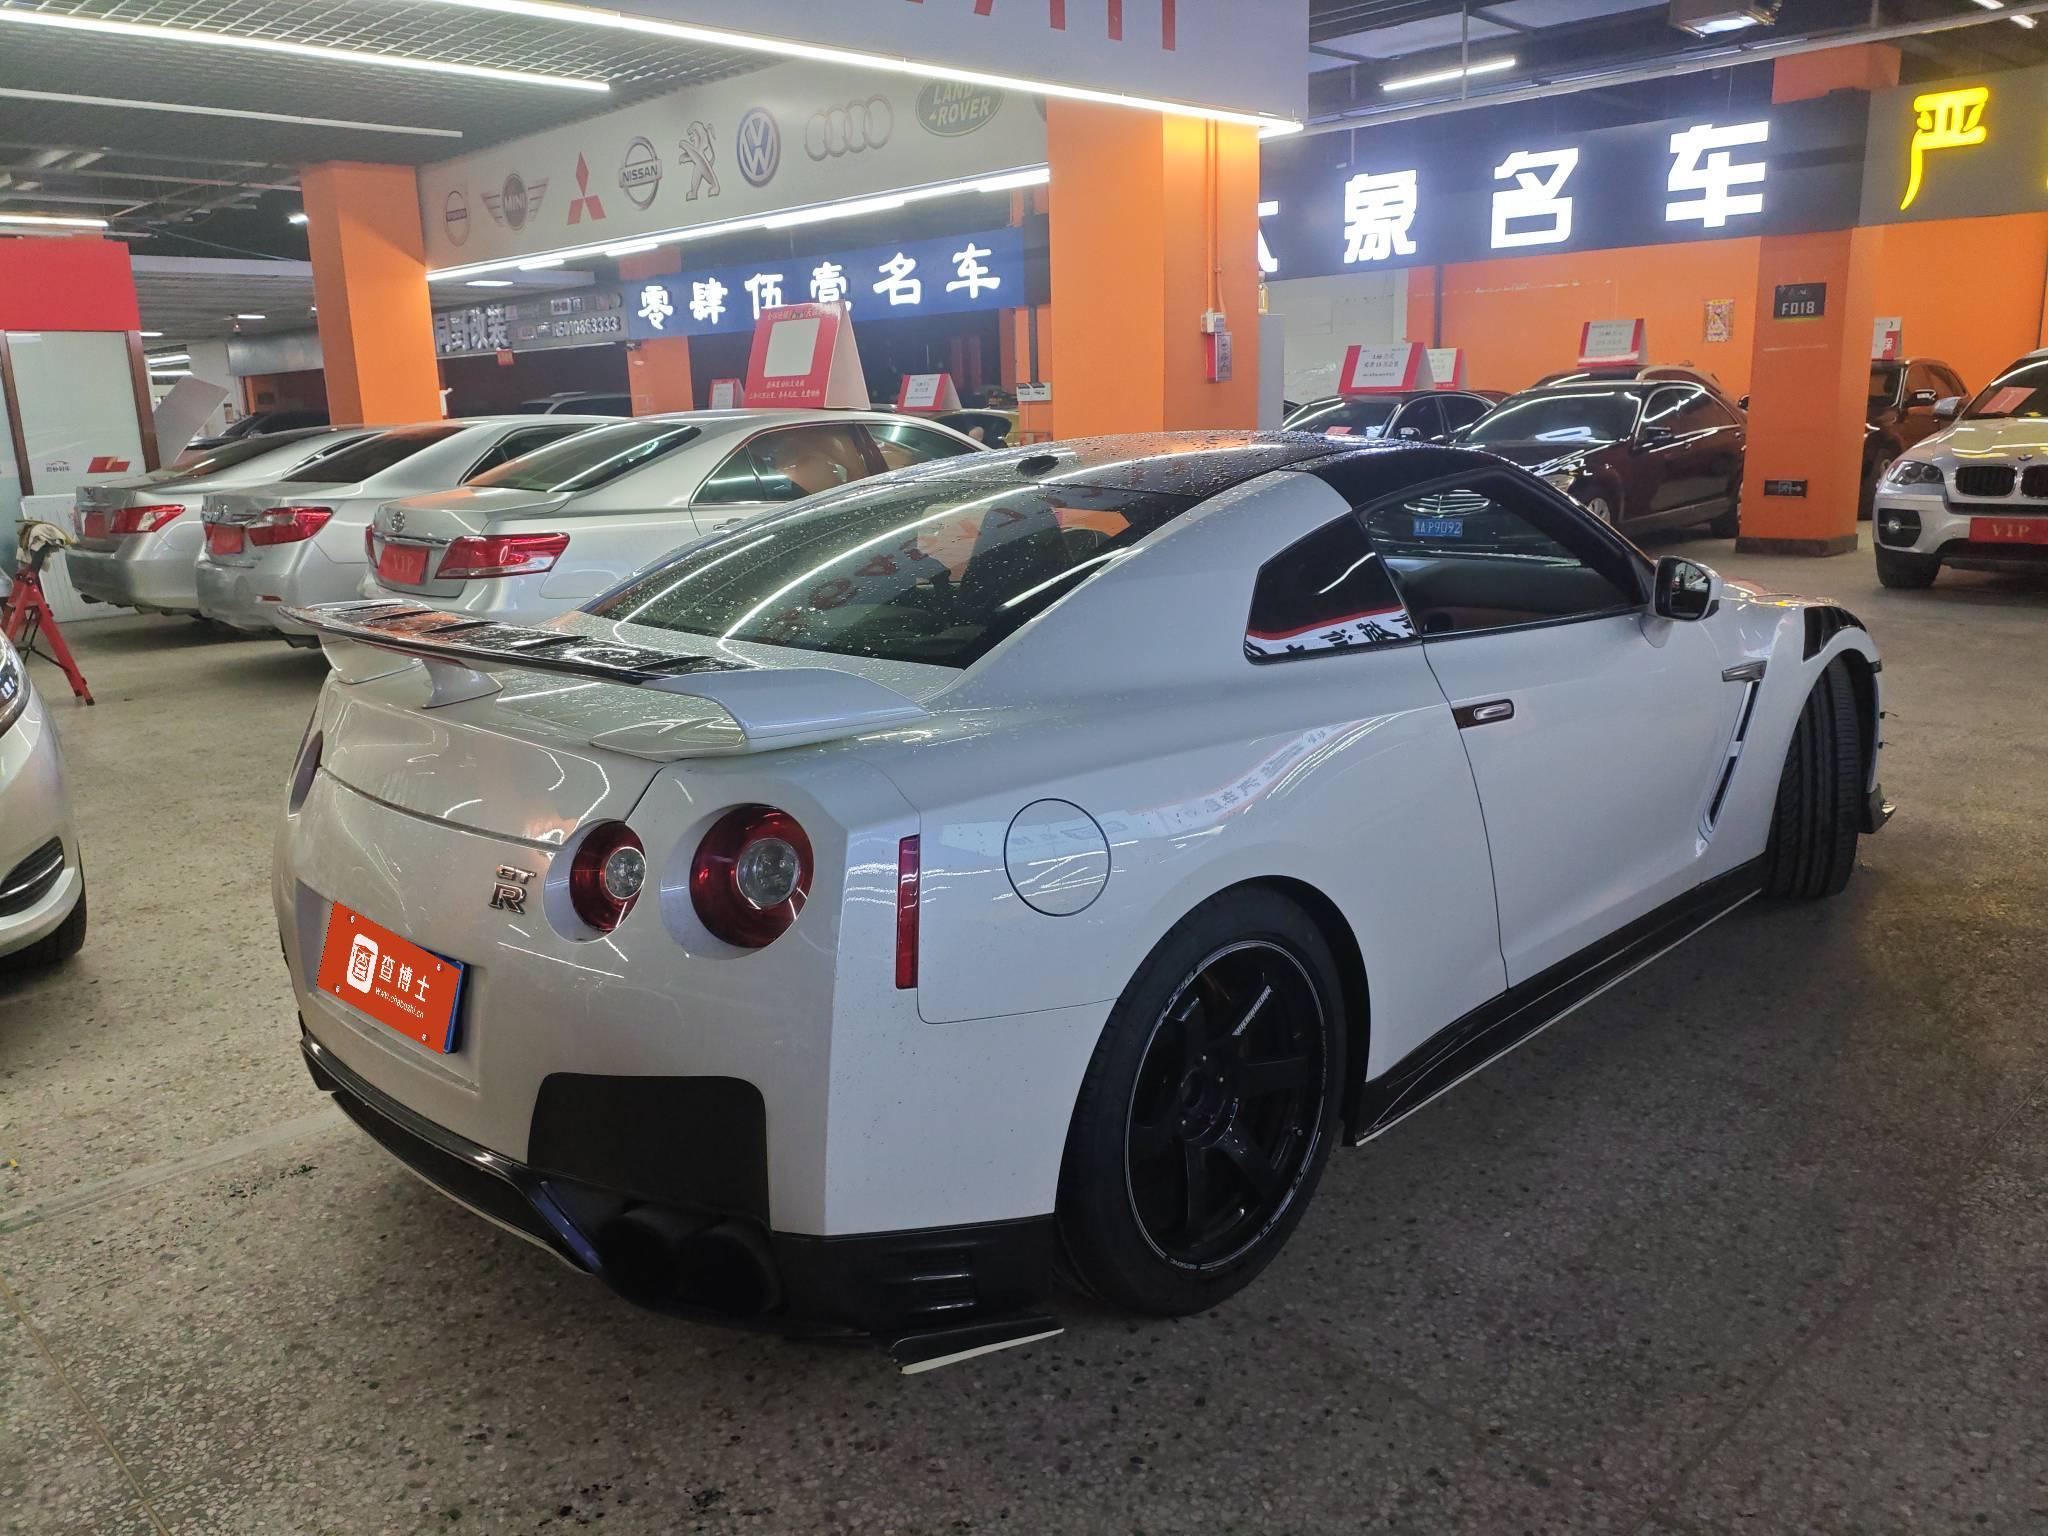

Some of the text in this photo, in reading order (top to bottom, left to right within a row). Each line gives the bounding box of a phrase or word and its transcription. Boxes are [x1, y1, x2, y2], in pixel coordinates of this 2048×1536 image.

[937, 96, 991, 127] ROVER
[622, 164, 658, 182] NISSAN
[504, 192, 525, 211] MINI
[638, 243, 1000, 330] 零肆伍壹名车
[1991, 523, 2030, 538] VIP
[495, 864, 536, 884] GT
[488, 881, 527, 914] R
